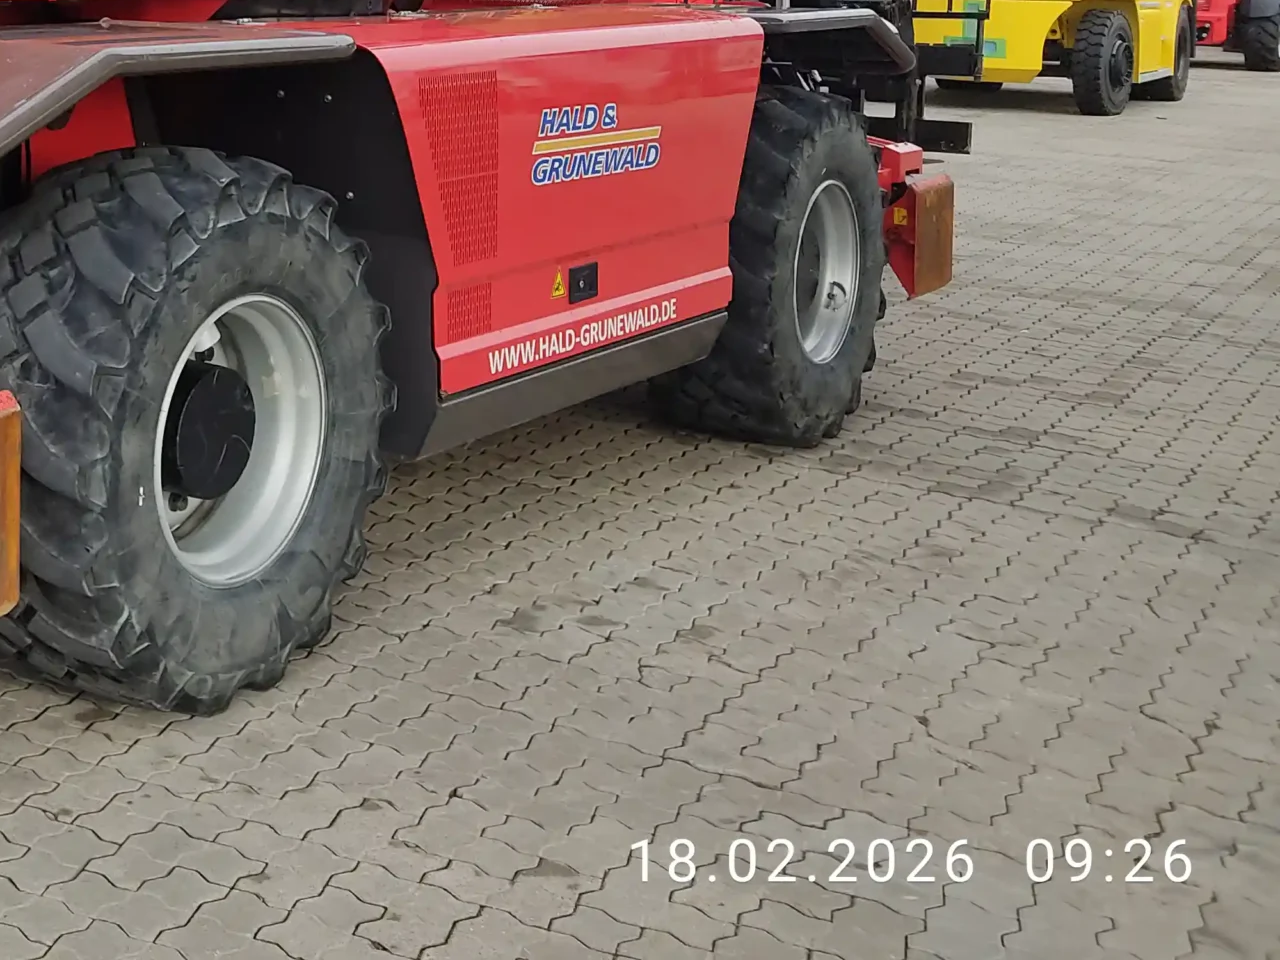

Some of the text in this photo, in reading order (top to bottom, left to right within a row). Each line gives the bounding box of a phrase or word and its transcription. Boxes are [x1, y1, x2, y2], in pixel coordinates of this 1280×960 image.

[538, 102, 618, 138] HALD &
[531, 142, 661, 186] GRUNEWALD
[488, 297, 678, 375] WWW.HALD-GRUNEWALD.DE
